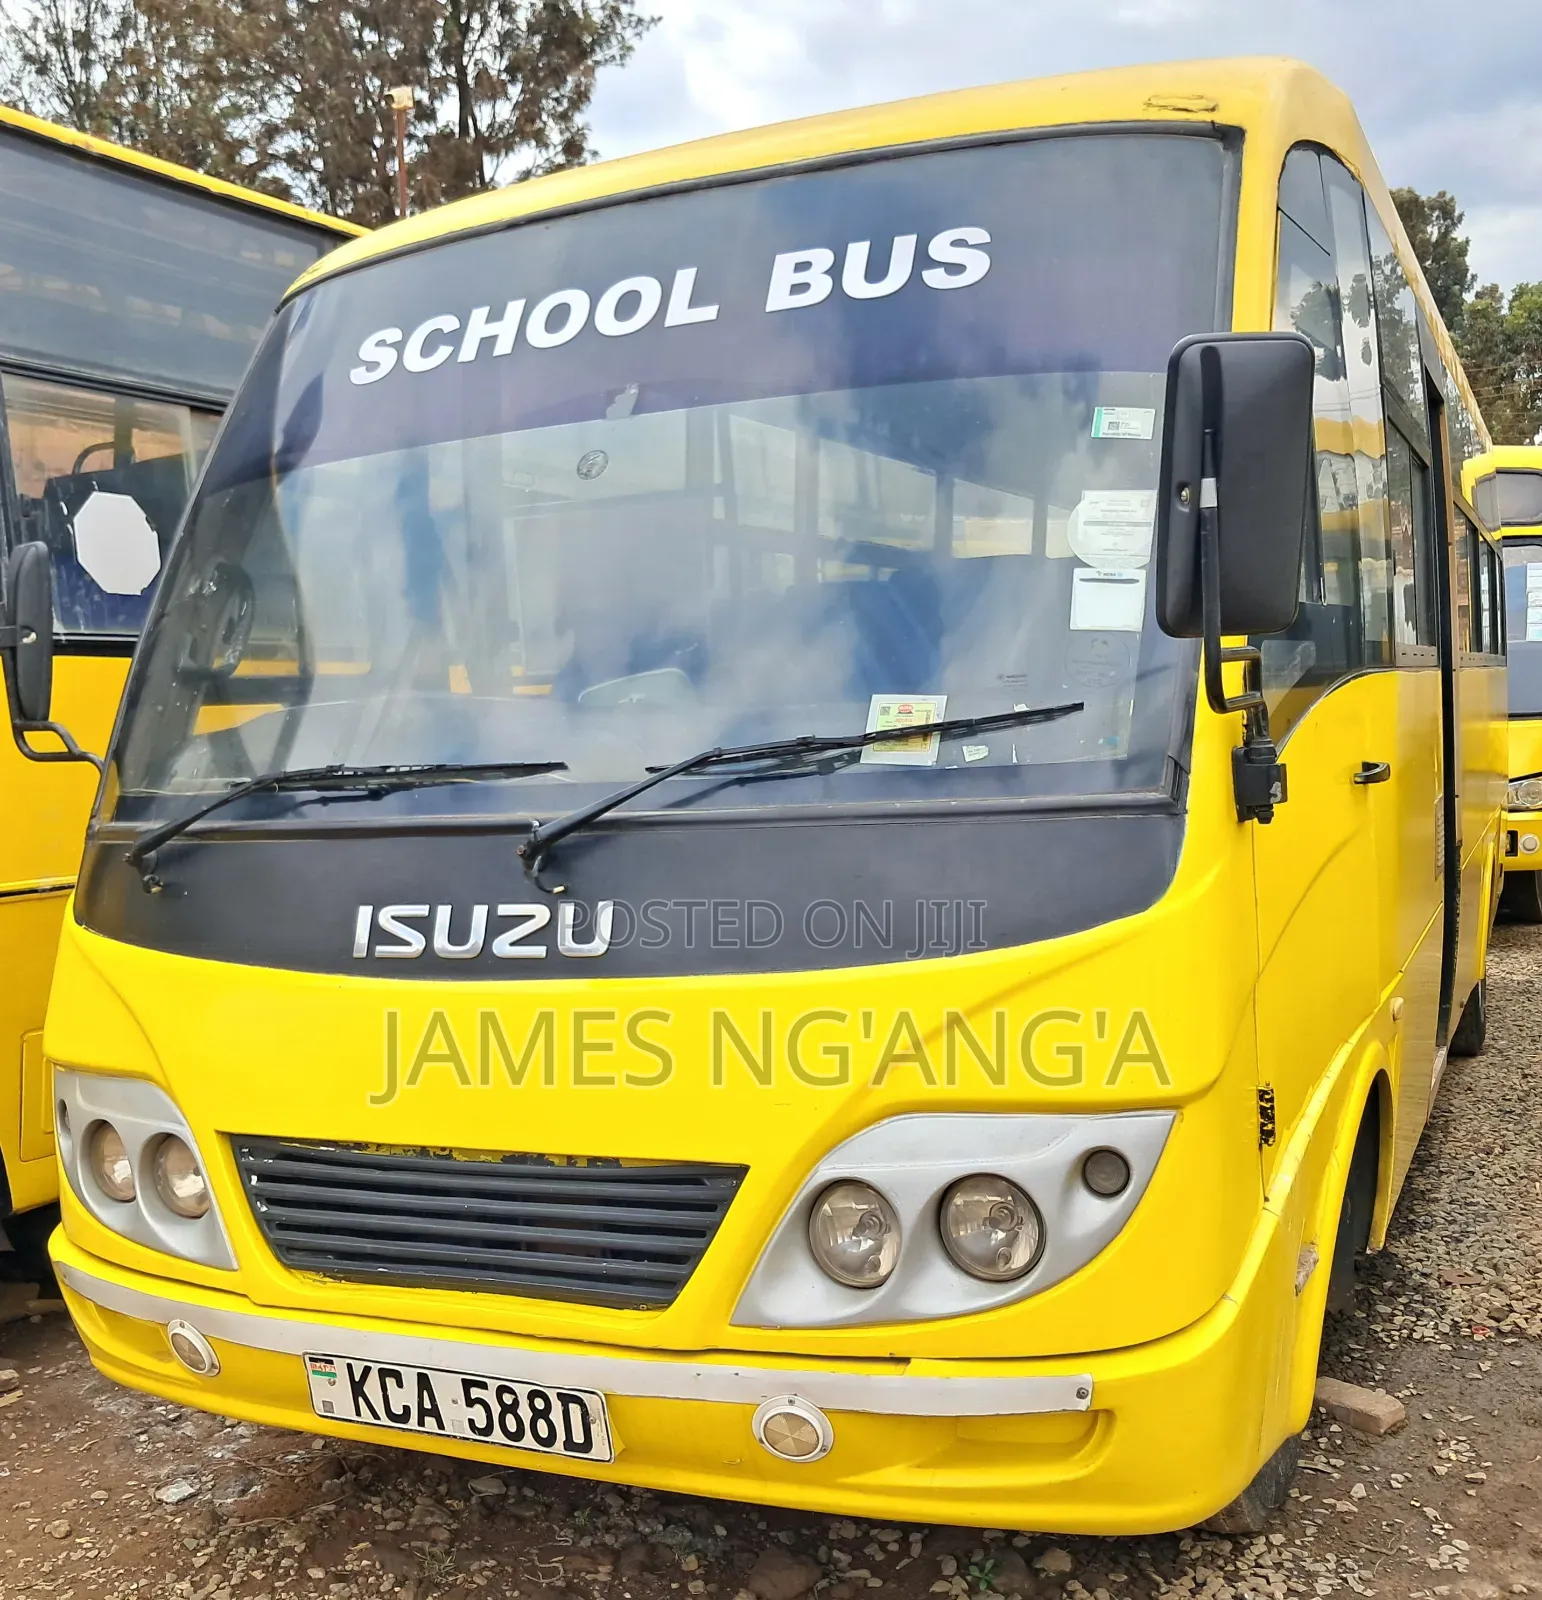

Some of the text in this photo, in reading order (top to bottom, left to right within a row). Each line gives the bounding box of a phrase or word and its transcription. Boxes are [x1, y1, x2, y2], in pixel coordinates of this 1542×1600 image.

[349, 226, 993, 386] SCHOOL BUS
[352, 900, 614, 959] ISUZU
[346, 1362, 594, 1454] KCA 588D
